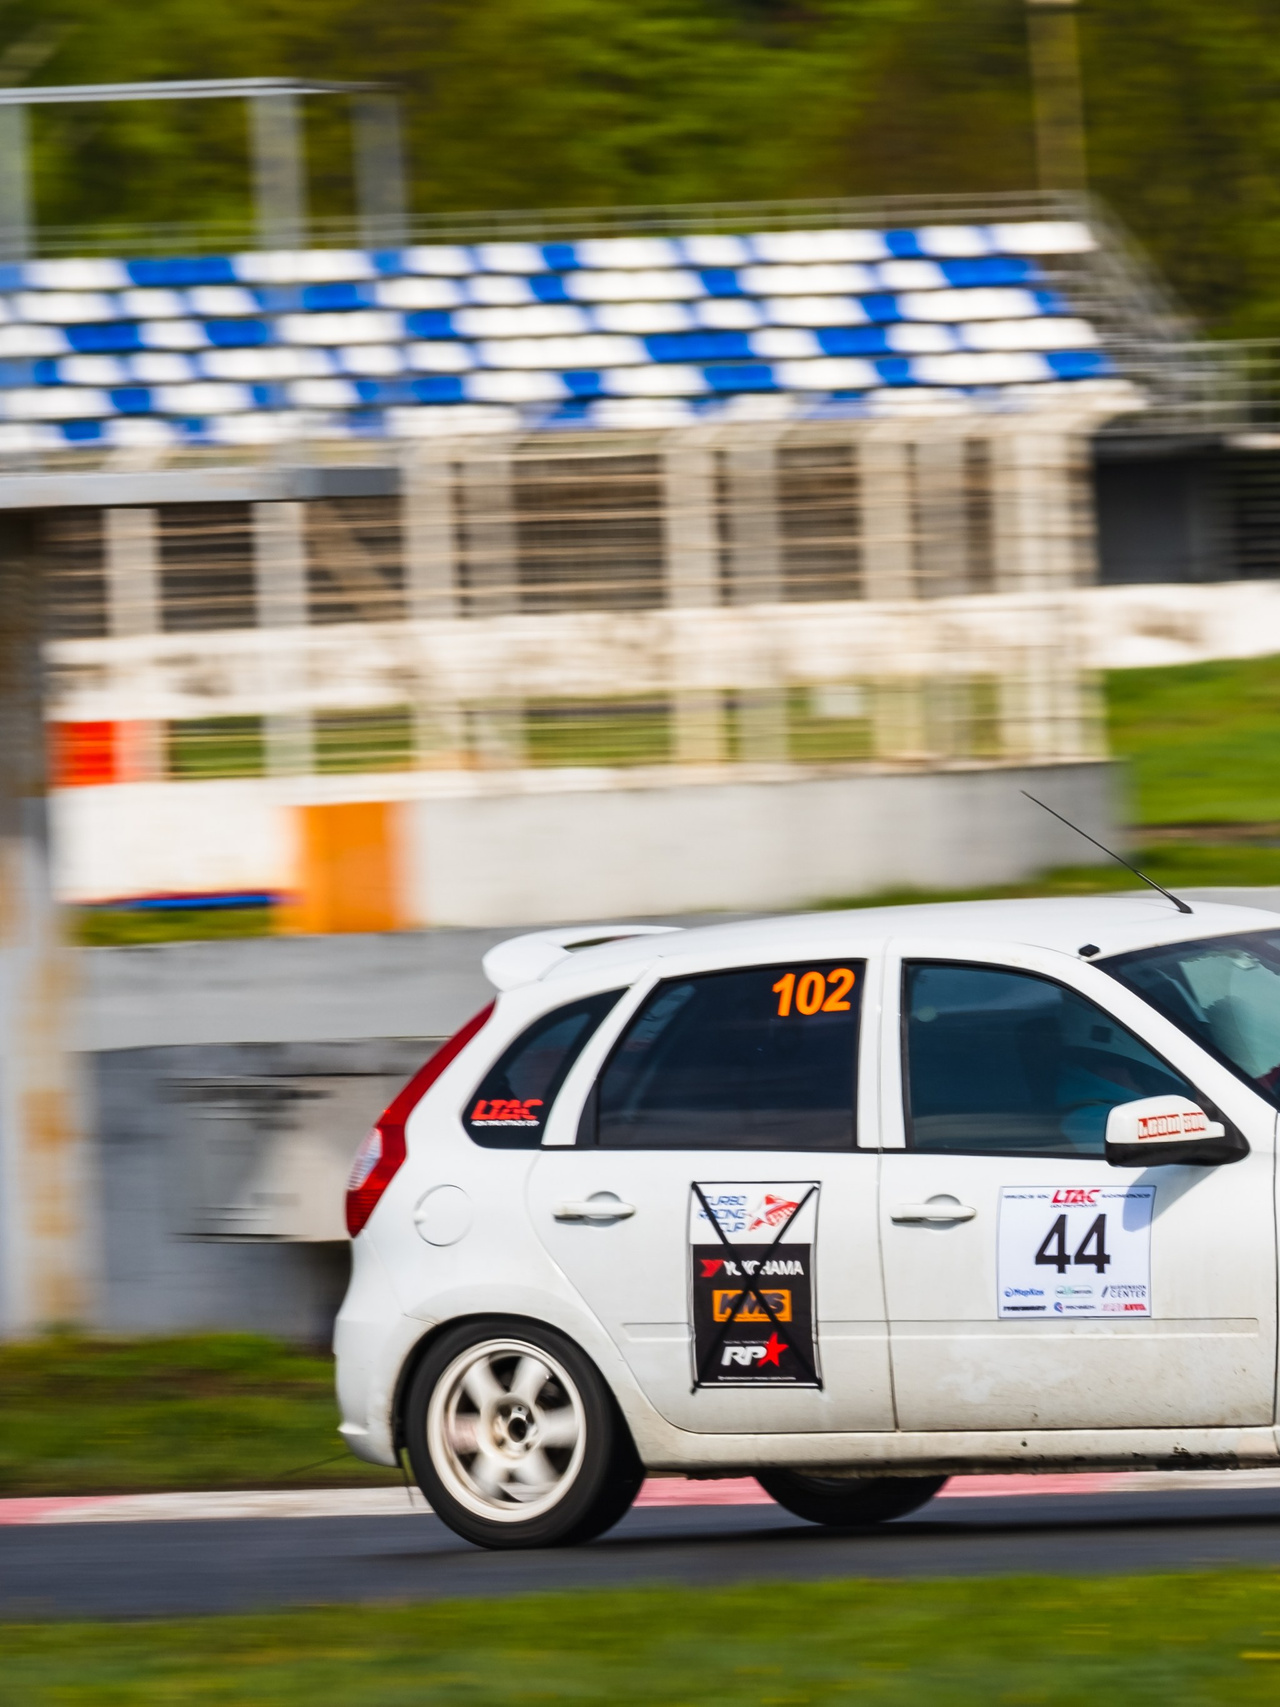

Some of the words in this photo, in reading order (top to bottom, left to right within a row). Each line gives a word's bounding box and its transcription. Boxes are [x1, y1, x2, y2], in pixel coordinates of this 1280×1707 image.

[772, 968, 856, 1017] 102
[470, 1099, 544, 1120] LTAC
[1051, 1189, 1101, 1204] LTAC
[698, 1208, 747, 1219] RCING
[1035, 1213, 1111, 1274] 44
[1110, 1290, 1147, 1299] CENTER
